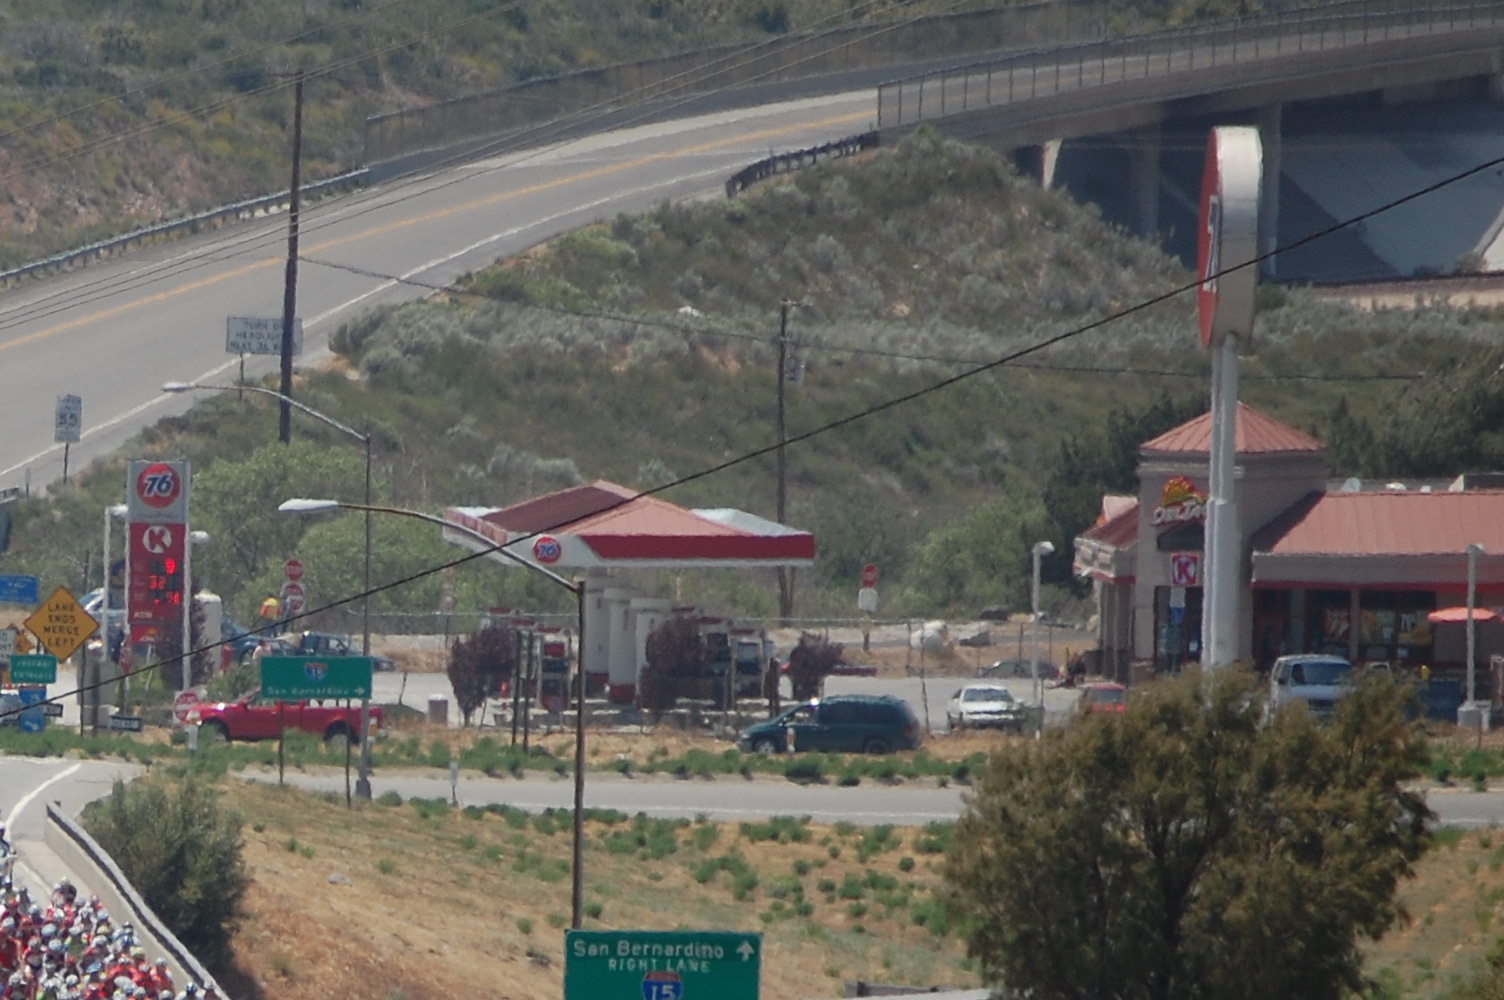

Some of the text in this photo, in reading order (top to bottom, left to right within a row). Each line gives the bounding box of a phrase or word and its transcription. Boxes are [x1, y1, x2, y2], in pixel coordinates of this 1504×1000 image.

[145, 474, 174, 496] 76
[48, 603, 75, 612] LANE
[48, 615, 76, 624] ENDS
[43, 626, 80, 636] MERGE
[47, 638, 75, 647] LEFT
[573, 939, 724, 959] San Bernardino
[608, 958, 711, 973] RIGHT LANE
